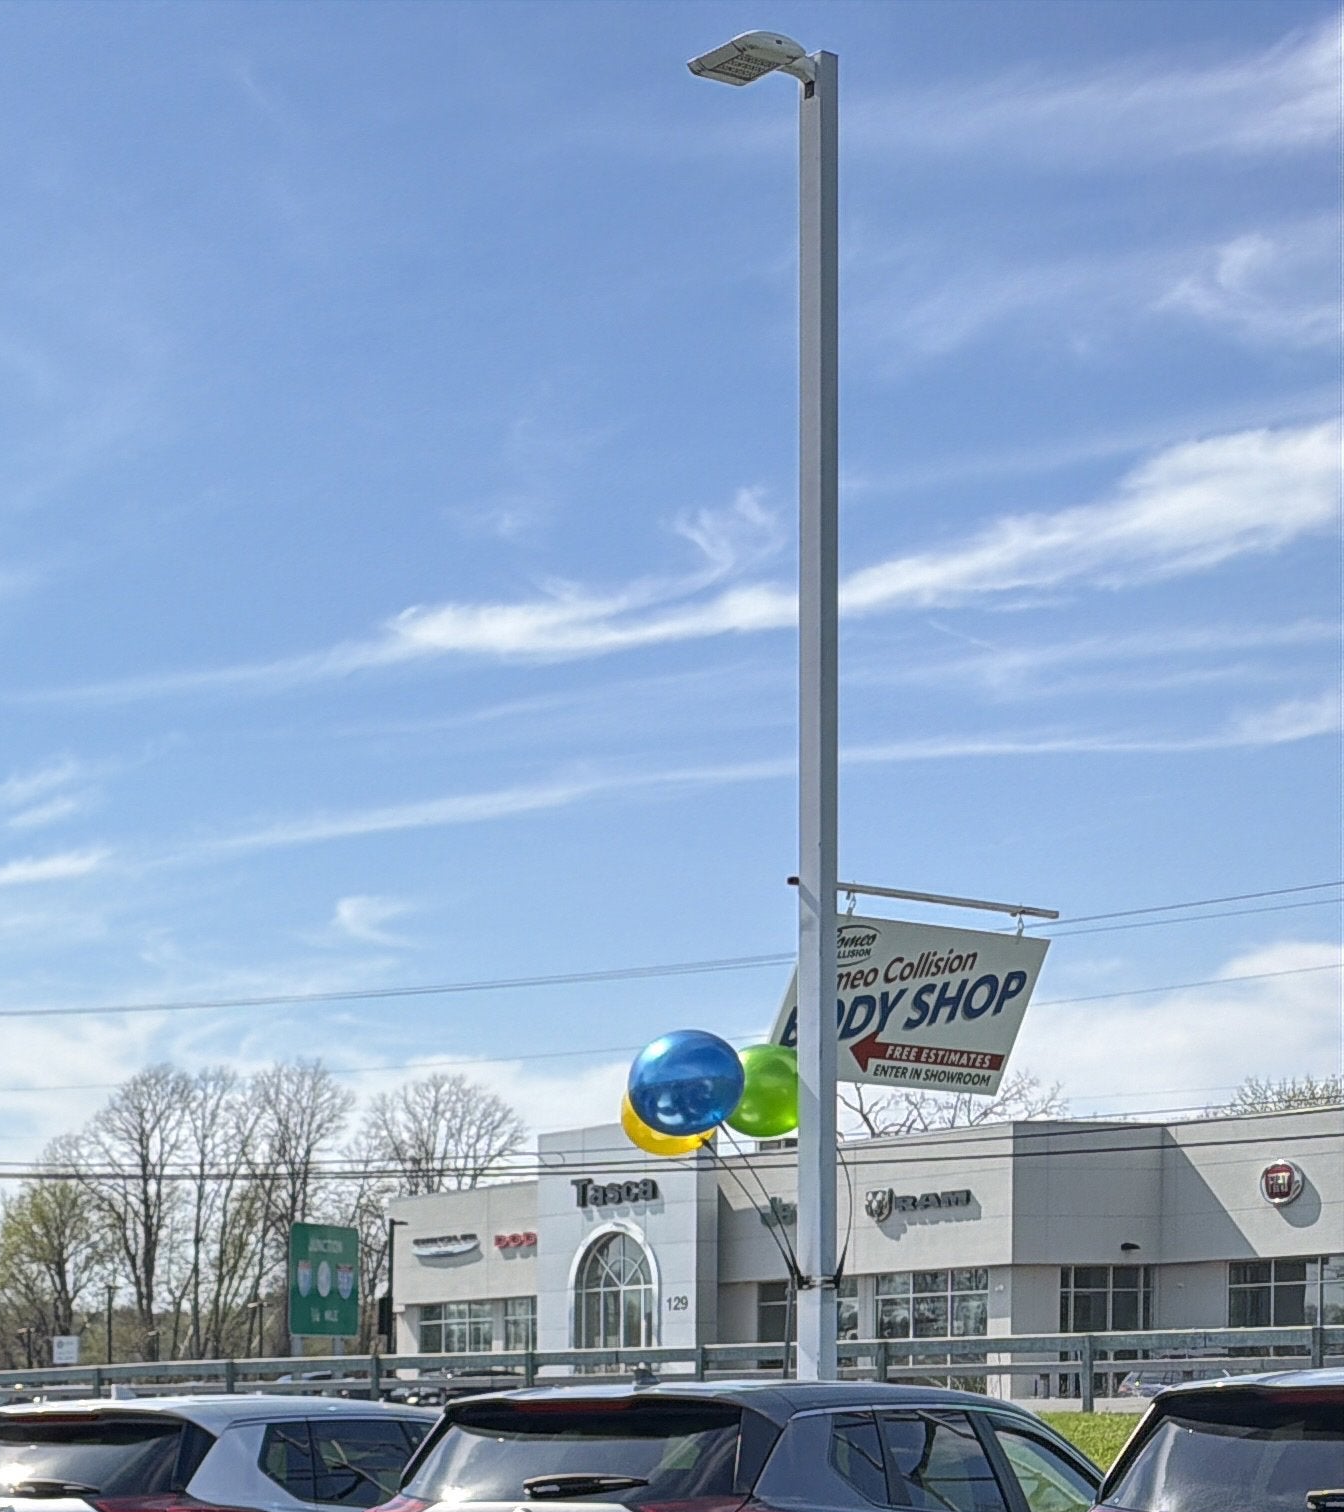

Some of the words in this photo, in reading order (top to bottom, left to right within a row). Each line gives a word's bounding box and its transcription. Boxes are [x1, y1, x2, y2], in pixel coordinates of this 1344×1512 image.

[883, 947, 978, 985] Collision
[902, 969, 1028, 1032] SHOP
[885, 1044, 919, 1062] FREE
[920, 1048, 993, 1069] ESTIMATES
[873, 1063, 908, 1081] ENTER
[908, 1066, 923, 1081] IN
[922, 1069, 993, 1087] SHOWROOM
[571, 1178, 660, 1208] Tasca
[894, 1189, 972, 1213] RAM
[666, 1295, 689, 1312] 129
